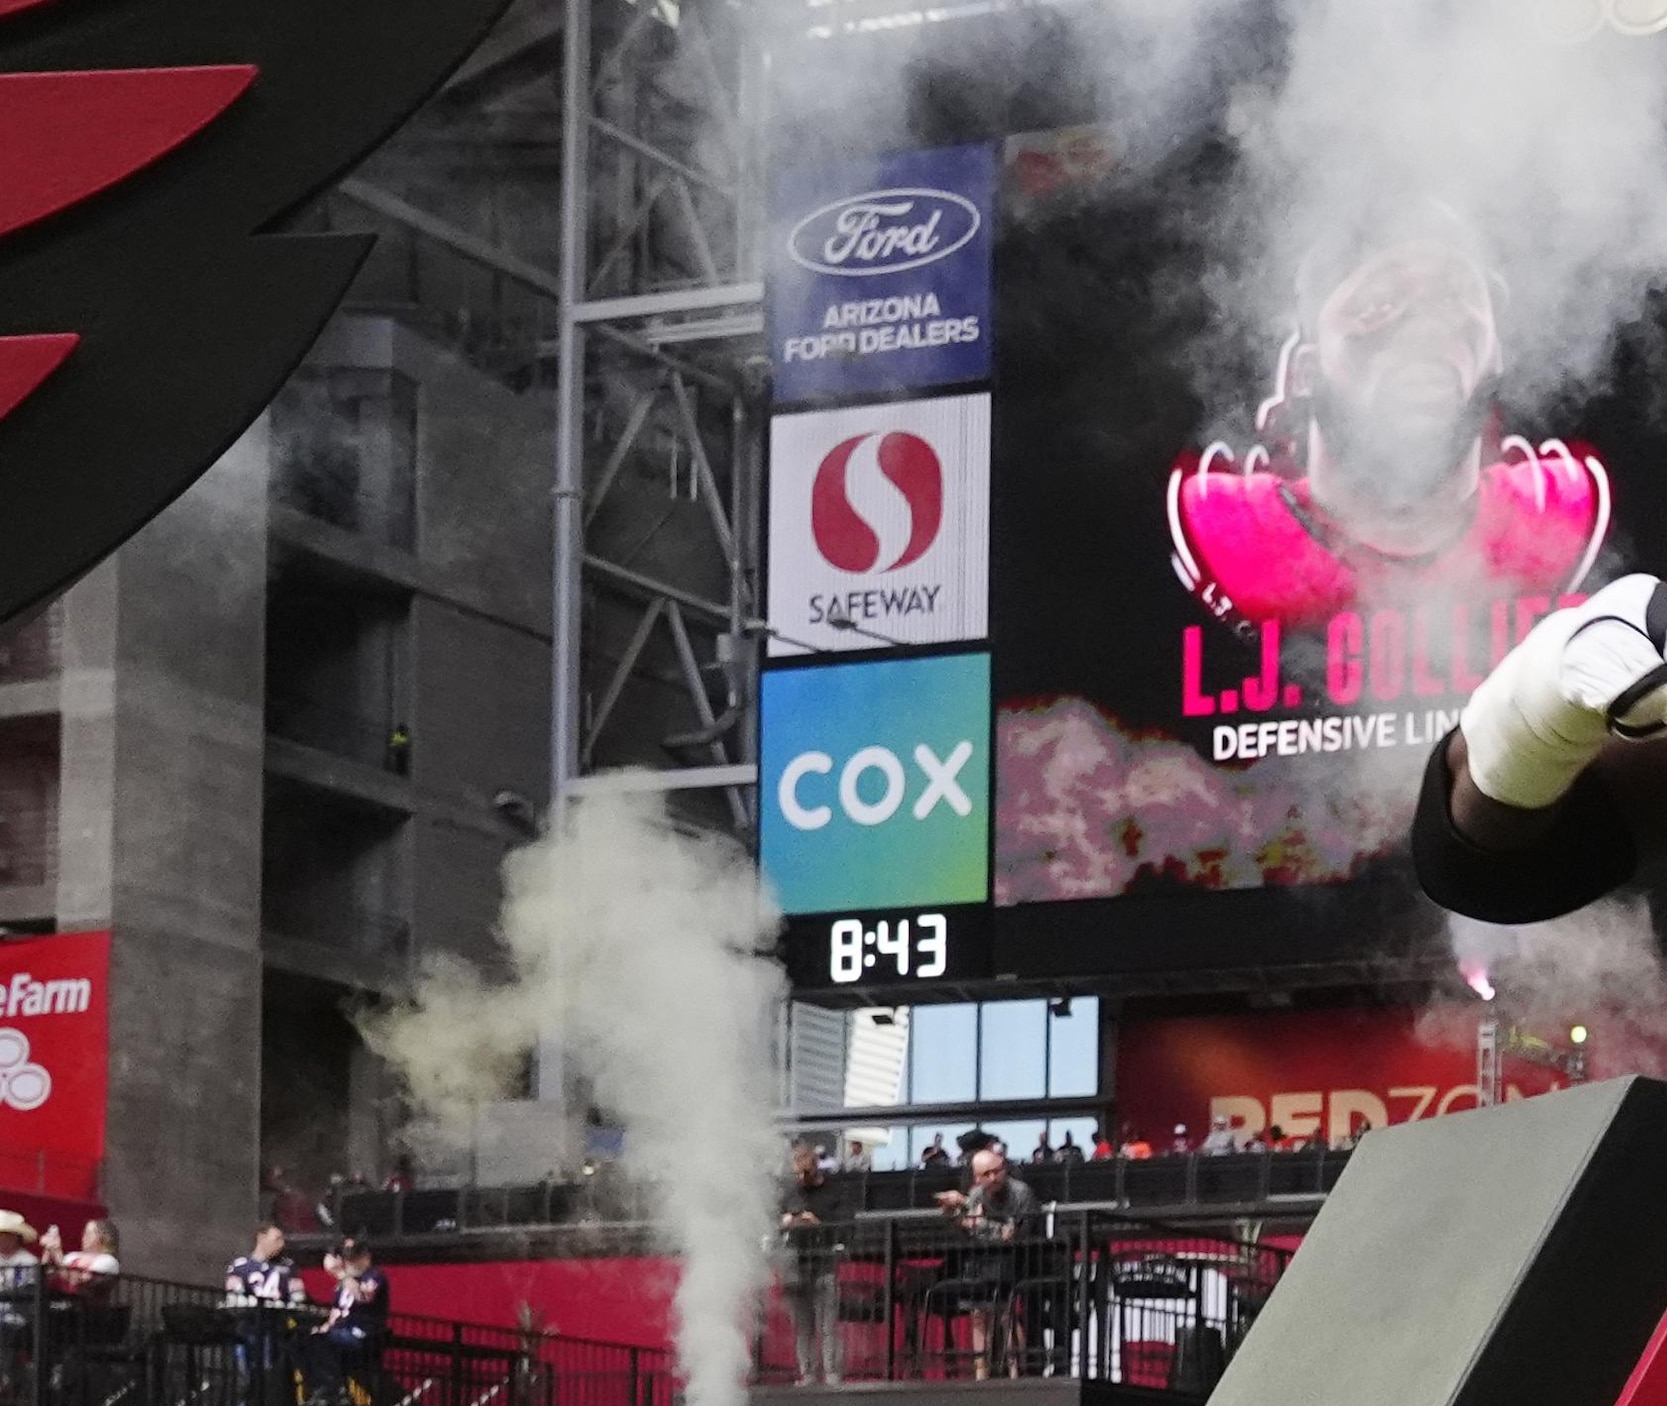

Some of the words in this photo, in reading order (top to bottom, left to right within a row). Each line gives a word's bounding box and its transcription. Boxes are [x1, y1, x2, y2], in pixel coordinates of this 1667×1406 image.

[824, 200, 944, 264] Ford
[823, 291, 942, 330] ARIZONA
[859, 314, 980, 354] DEALERS
[808, 584, 941, 626] SAFEWAY
[1182, 617, 1302, 717] L.J.
[1326, 592, 1592, 707] COLLI
[1213, 712, 1398, 761] DEFENSIVE
[778, 739, 974, 831] COX
[830, 913, 947, 983] 8:43
